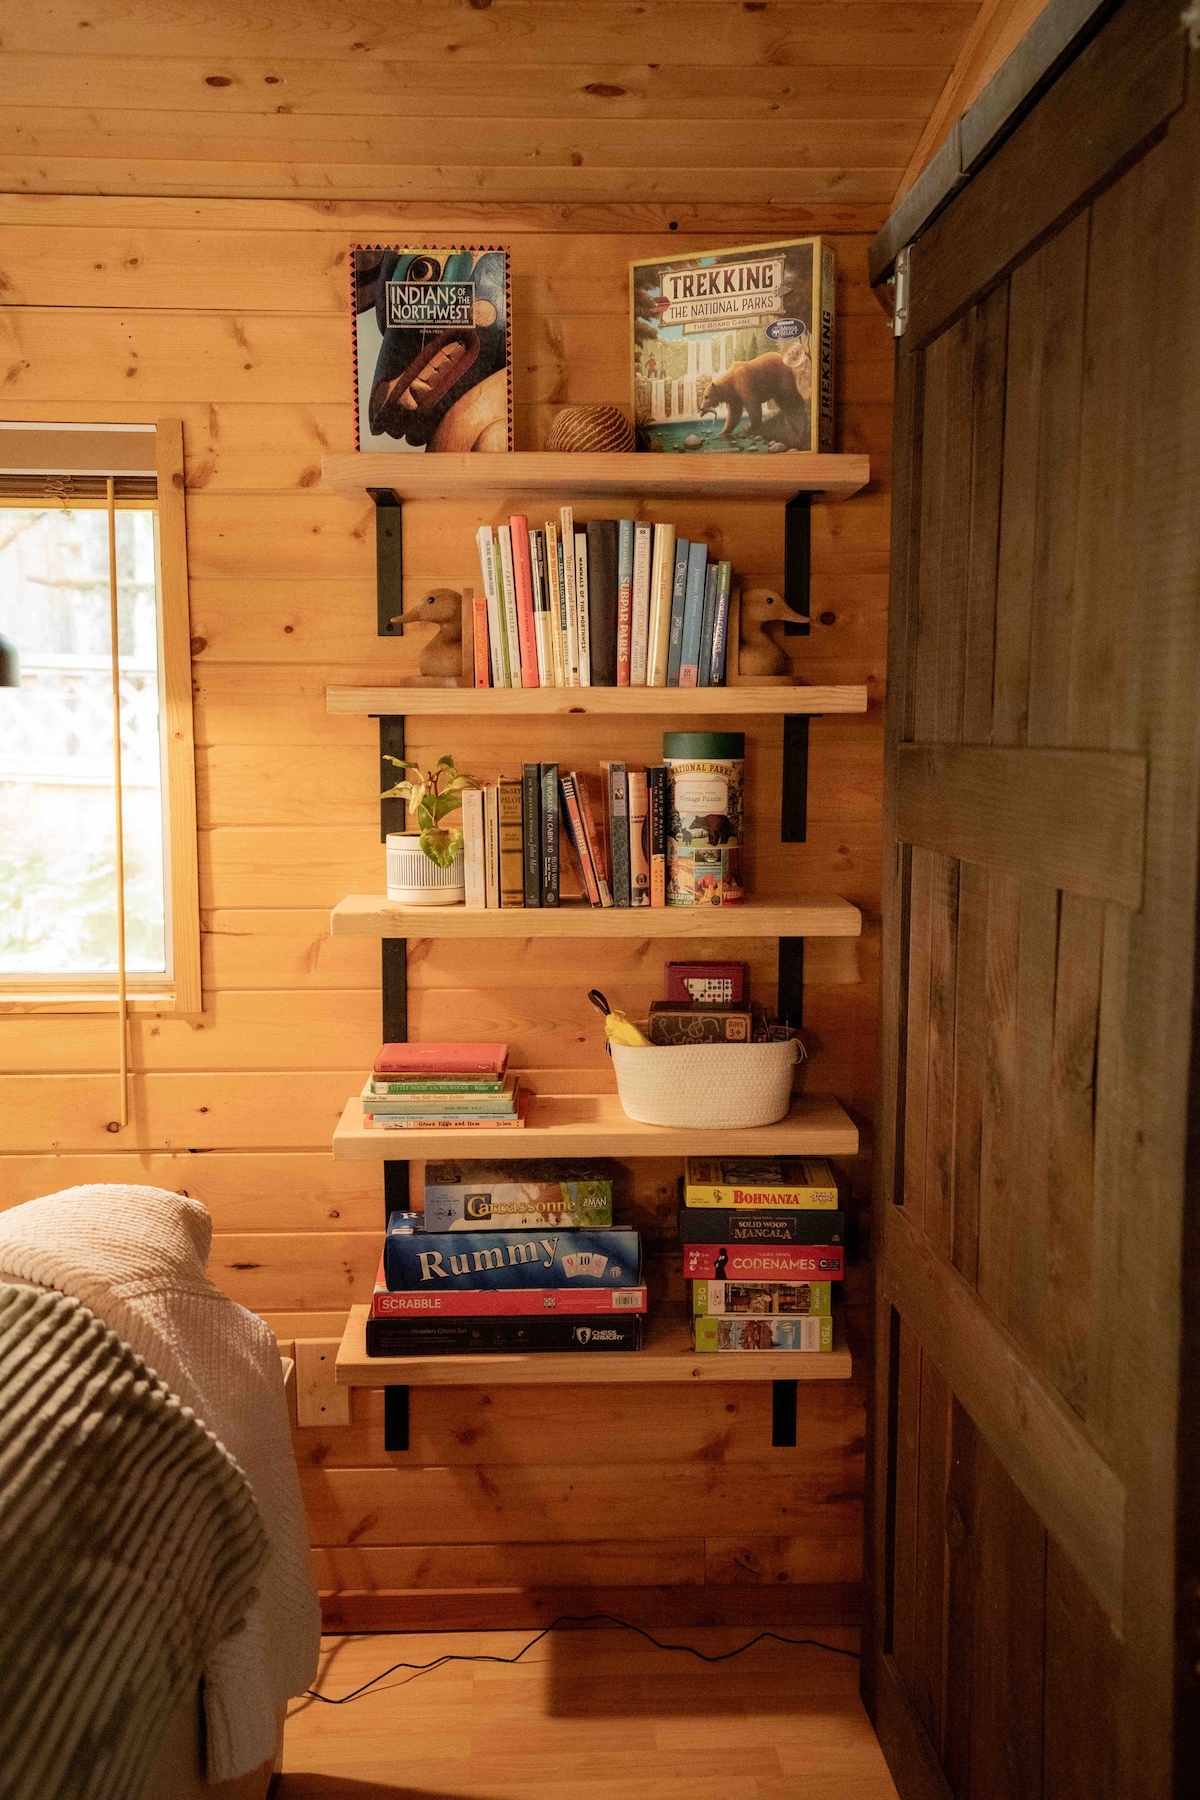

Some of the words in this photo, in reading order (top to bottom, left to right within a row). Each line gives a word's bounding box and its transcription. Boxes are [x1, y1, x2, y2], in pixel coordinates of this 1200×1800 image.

[670, 264, 773, 299] TREKKING
[391, 286, 457, 305] INDIANS
[457, 288, 466, 296] OF
[457, 296, 470, 304] THE
[391, 305, 470, 319] NORTHWEST
[670, 306, 688, 319] THE
[690, 302, 739, 317] NATIONAL
[742, 296, 774, 310] PARKS
[708, 321, 731, 329] BOARD
[731, 319, 751, 327] GAME
[822, 310, 831, 419] TREKKING
[550, 560, 556, 568] TO
[565, 555, 573, 572] Your
[637, 560, 645, 597] MAKING
[692, 567, 700, 593] Japanese
[566, 574, 574, 603] Natural
[579, 590, 584, 598] OF
[619, 576, 629, 621] SUBPAR
[507, 606, 515, 634] SKILLET
[636, 610, 645, 637] HOME
[618, 624, 628, 661] PARKS
[715, 621, 723, 652] CASCADES
[671, 764, 706, 776] NATIONAL
[710, 764, 733, 777] PARKS
[658, 806, 662, 815] OF
[572, 817, 588, 855] SASQUATCH
[527, 842, 536, 857] John
[546, 844, 553, 852] 10
[729, 1020, 744, 1028] Ages
[730, 1028, 742, 1037] 3+
[733, 1190, 800, 1205] BOHNANZA
[467, 1195, 577, 1218] Carcassonne
[733, 1229, 792, 1240] MANCALA
[416, 1237, 559, 1282] Rummy
[566, 1258, 574, 1267] 9
[579, 1255, 590, 1266] 10
[733, 1257, 816, 1270] CODENAMES
[382, 1298, 441, 1309] SCRABBLE
[697, 1288, 707, 1307] 750
[821, 1325, 830, 1345] 750
